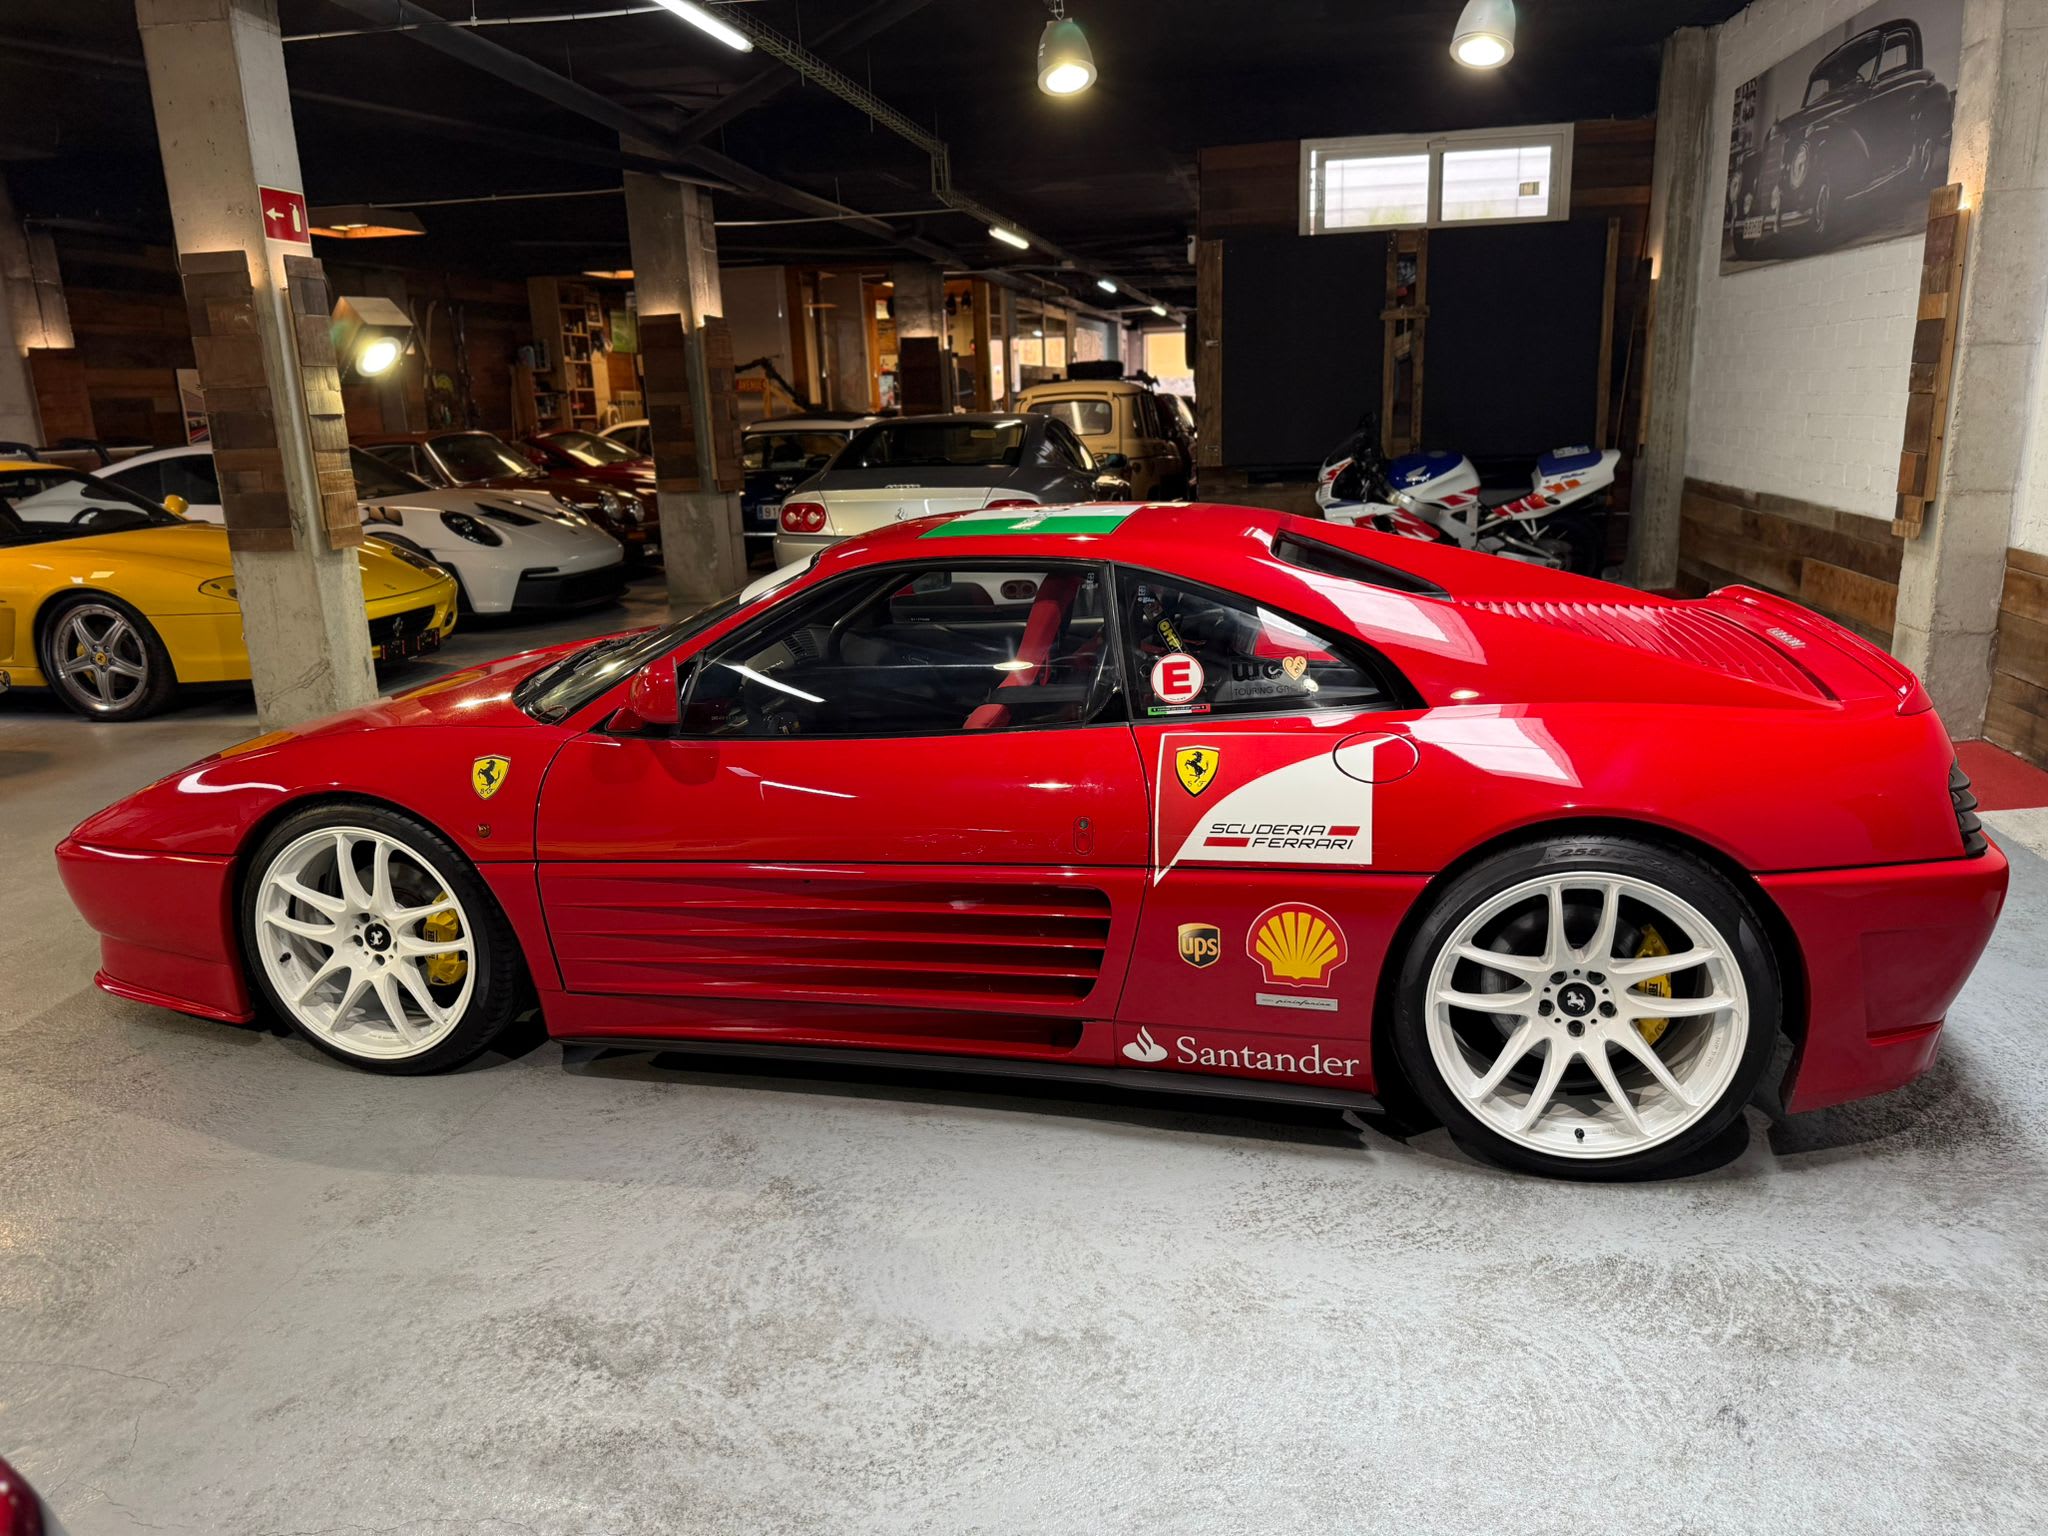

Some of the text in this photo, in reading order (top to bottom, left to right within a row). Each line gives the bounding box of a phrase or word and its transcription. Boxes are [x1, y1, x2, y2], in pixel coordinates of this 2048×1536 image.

[1162, 661, 1192, 695] E
[1234, 686, 1274, 697] TOURING
[1210, 823, 1326, 836] SCUDERIA
[1252, 837, 1354, 849] FERRARI
[1182, 936, 1217, 962] ups
[1176, 1036, 1360, 1077] Santander
